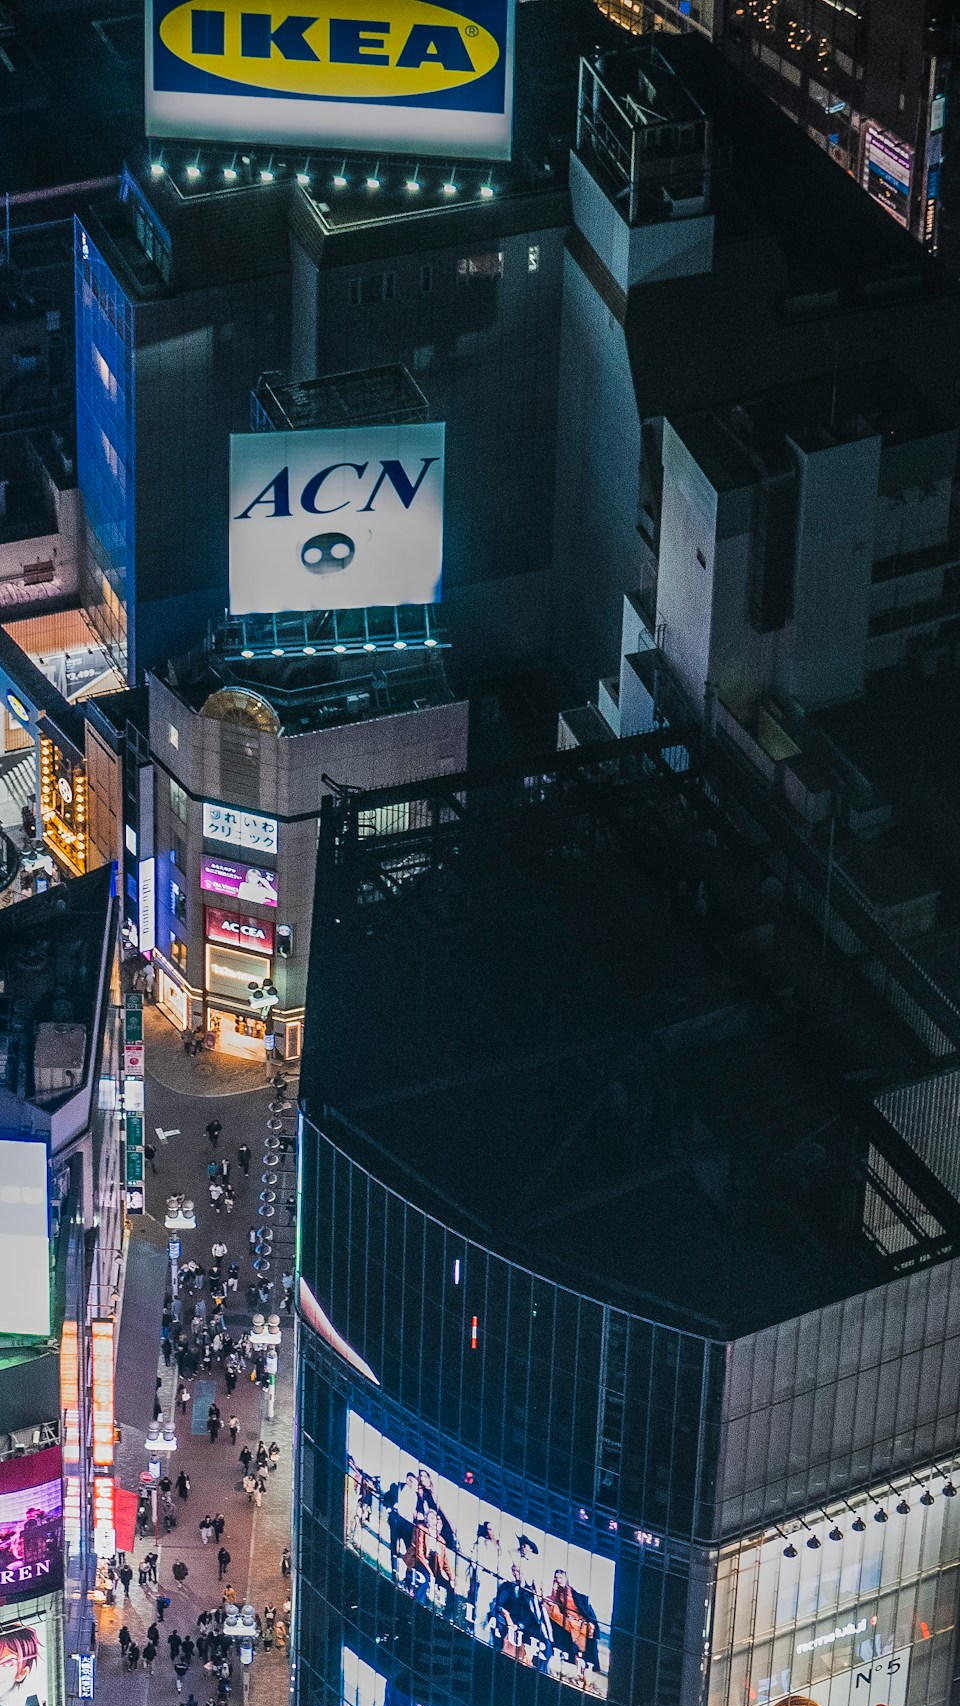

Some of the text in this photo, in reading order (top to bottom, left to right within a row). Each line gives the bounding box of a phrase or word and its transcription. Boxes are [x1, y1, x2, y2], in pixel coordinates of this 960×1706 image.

[190, 10, 477, 73] IKEA
[233, 457, 439, 520] ACN
[208, 823, 275, 847] クリニック
[224, 811, 275, 833] れいわ
[221, 920, 266, 939] ACCEA
[465, 1602, 595, 1673] LAUREN
